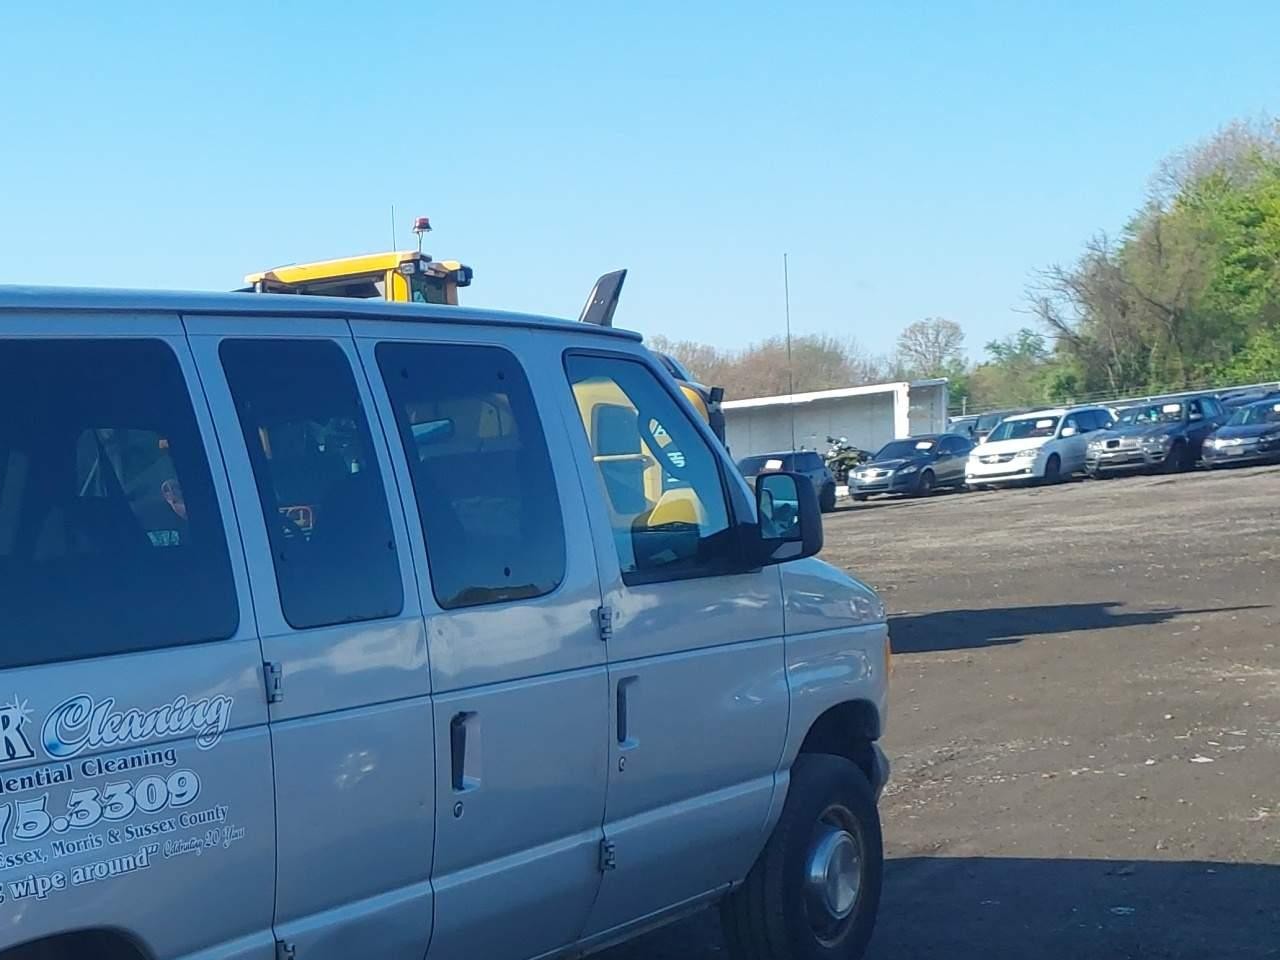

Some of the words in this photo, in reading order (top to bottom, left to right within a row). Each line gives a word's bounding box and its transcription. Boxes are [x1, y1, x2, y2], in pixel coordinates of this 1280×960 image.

[41, 692, 232, 751] Cleaning
[81, 747, 177, 778] Cleaning
[52, 833, 103, 859] Morris
[106, 829, 121, 844] &
[125, 819, 176, 842] Sussex
[179, 805, 229, 829] County
[204, 827, 221, 848] 20
[8, 870, 66, 900] wipe
